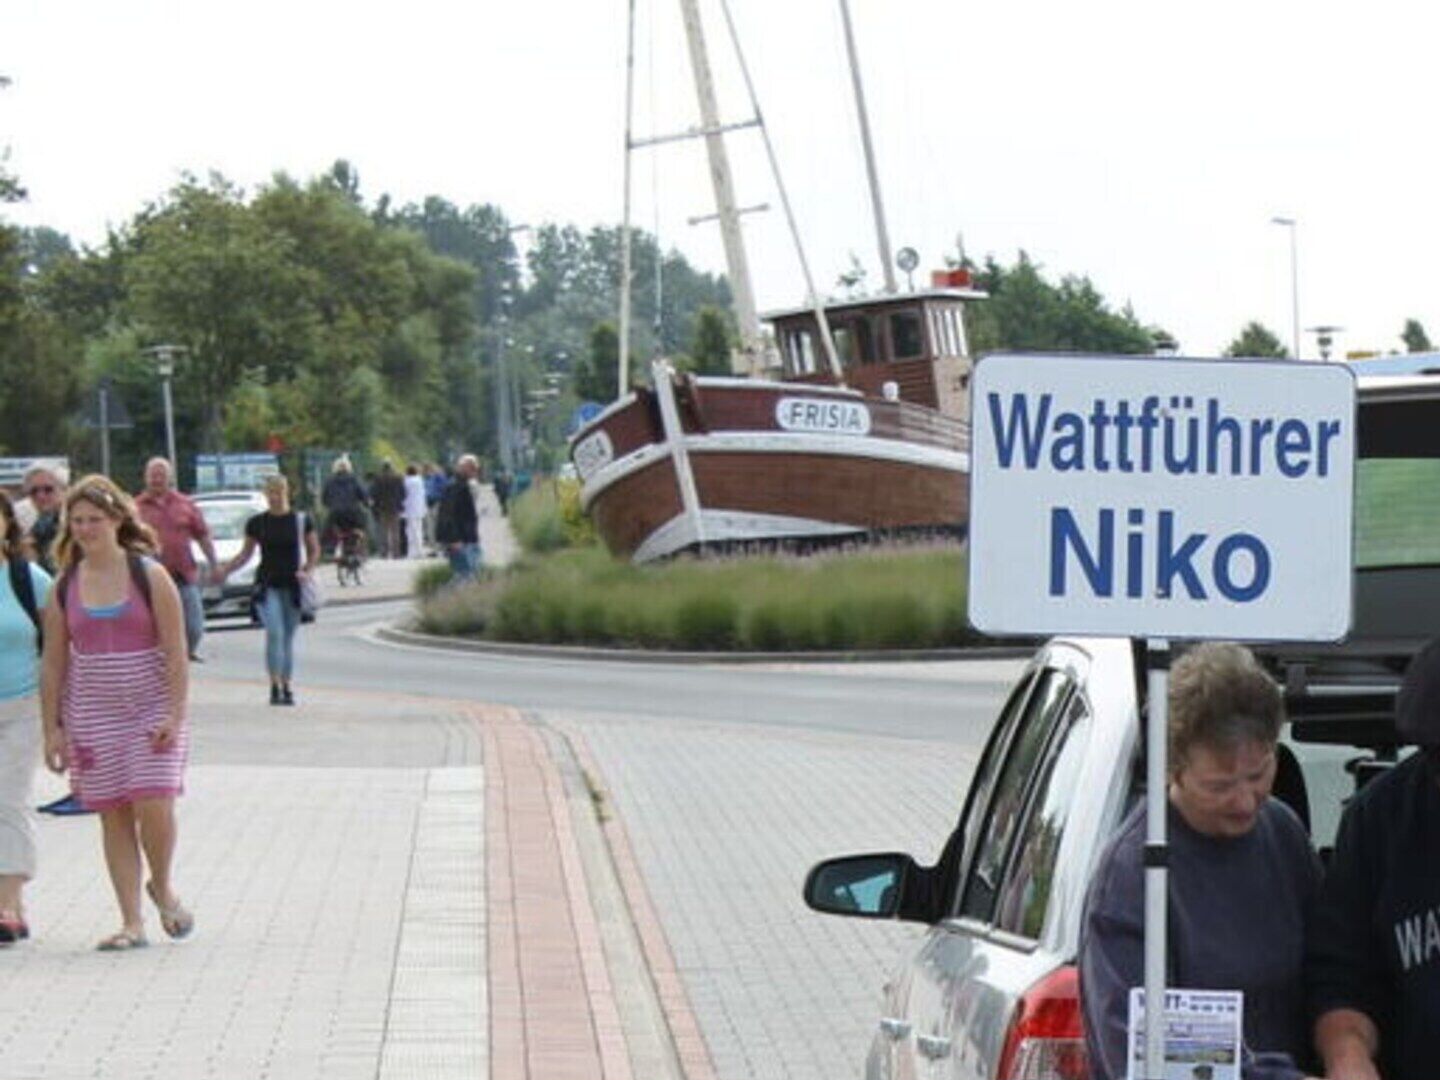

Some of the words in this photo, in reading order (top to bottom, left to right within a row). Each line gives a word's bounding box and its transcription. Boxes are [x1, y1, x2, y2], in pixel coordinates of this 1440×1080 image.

[787, 401, 862, 430] FRISIA
[986, 391, 1341, 478] Wattführer
[1048, 506, 1272, 603] Niko
